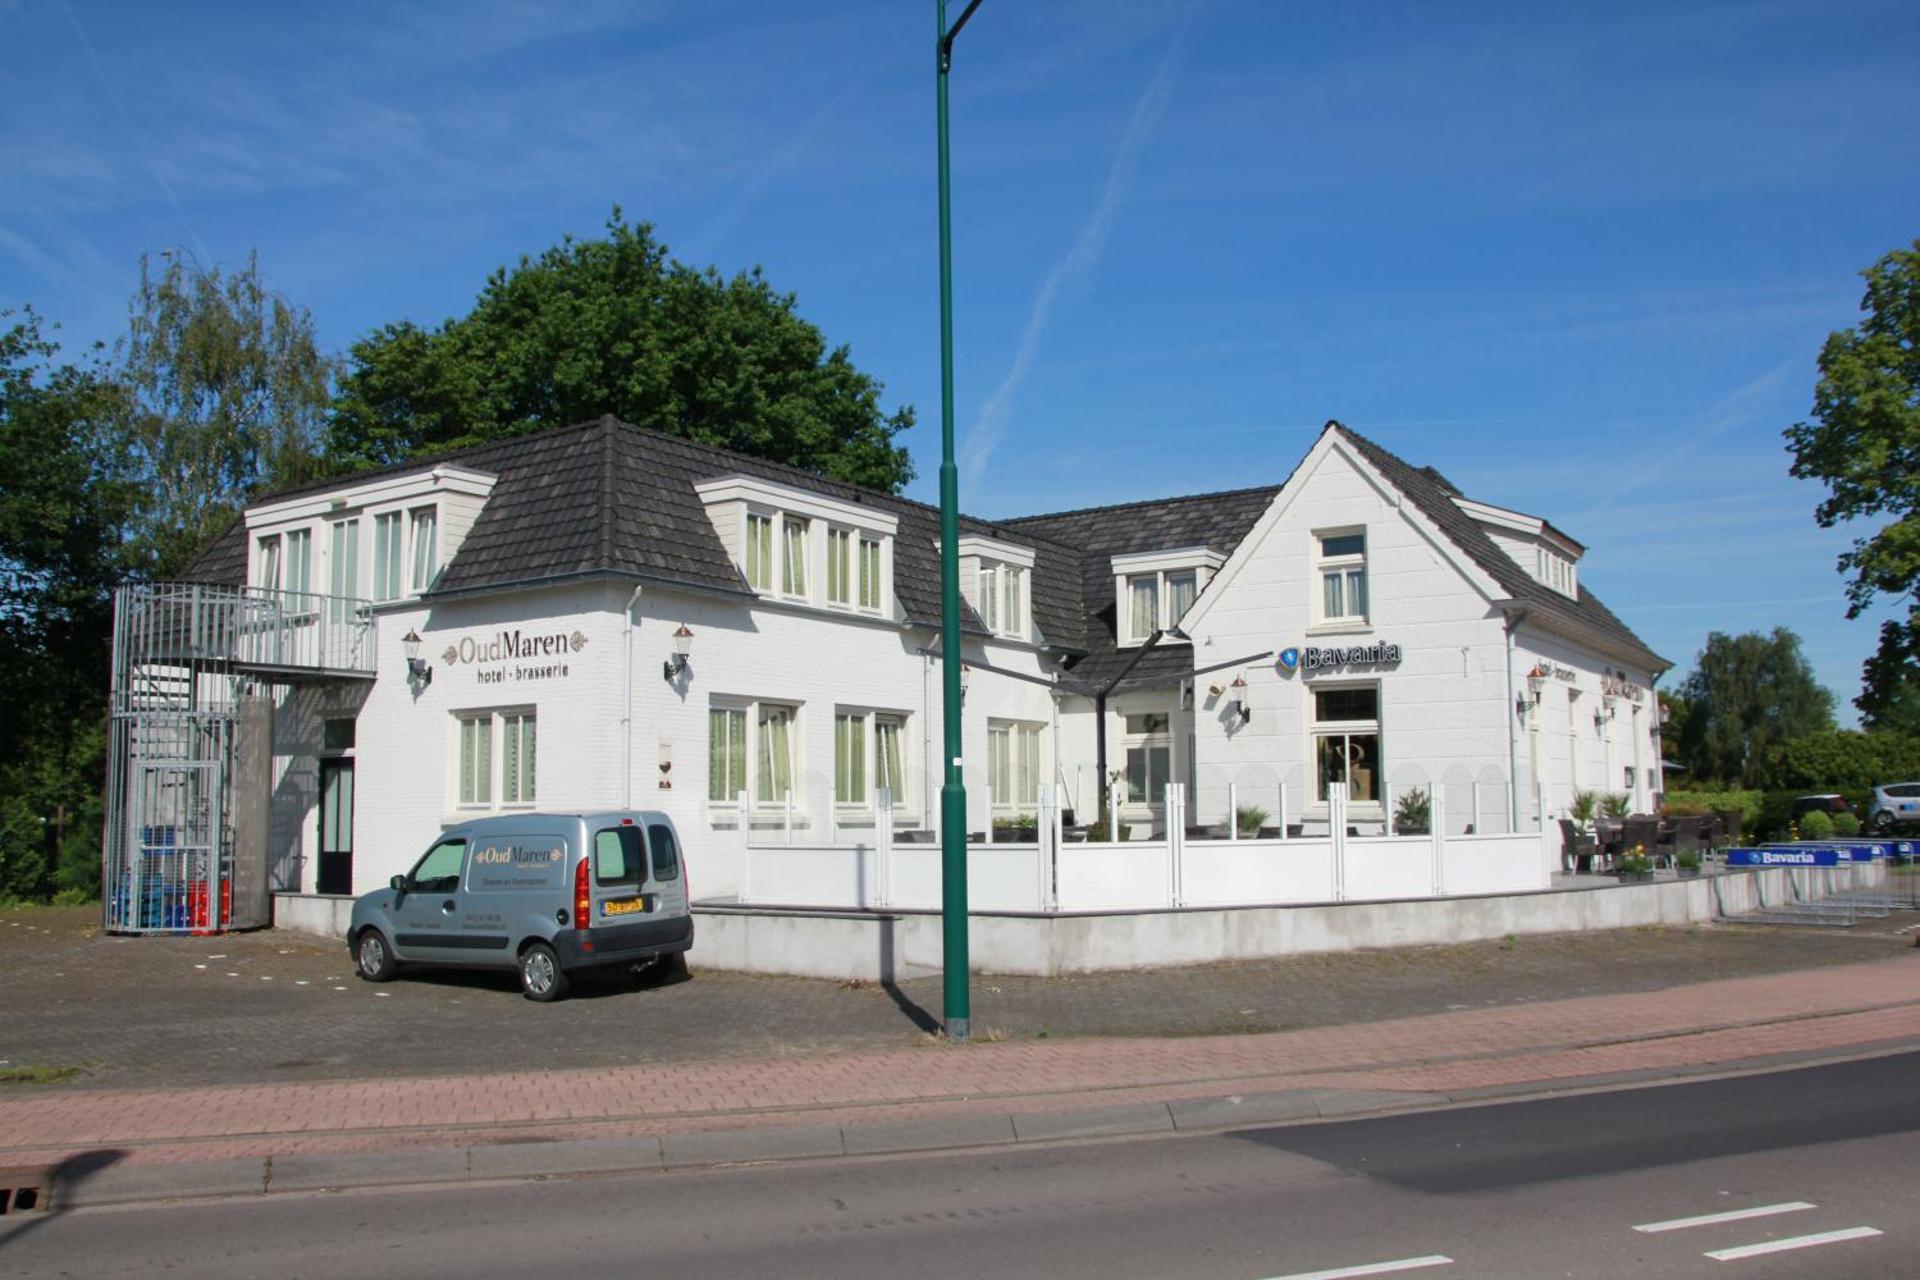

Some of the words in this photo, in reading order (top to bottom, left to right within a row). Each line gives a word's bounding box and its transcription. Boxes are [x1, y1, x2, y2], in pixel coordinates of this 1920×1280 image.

[1304, 640, 1401, 669] Bavaria
[478, 666, 506, 684] hotel
[516, 662, 569, 681] brasserie
[1762, 851, 1814, 864] Bavaria
